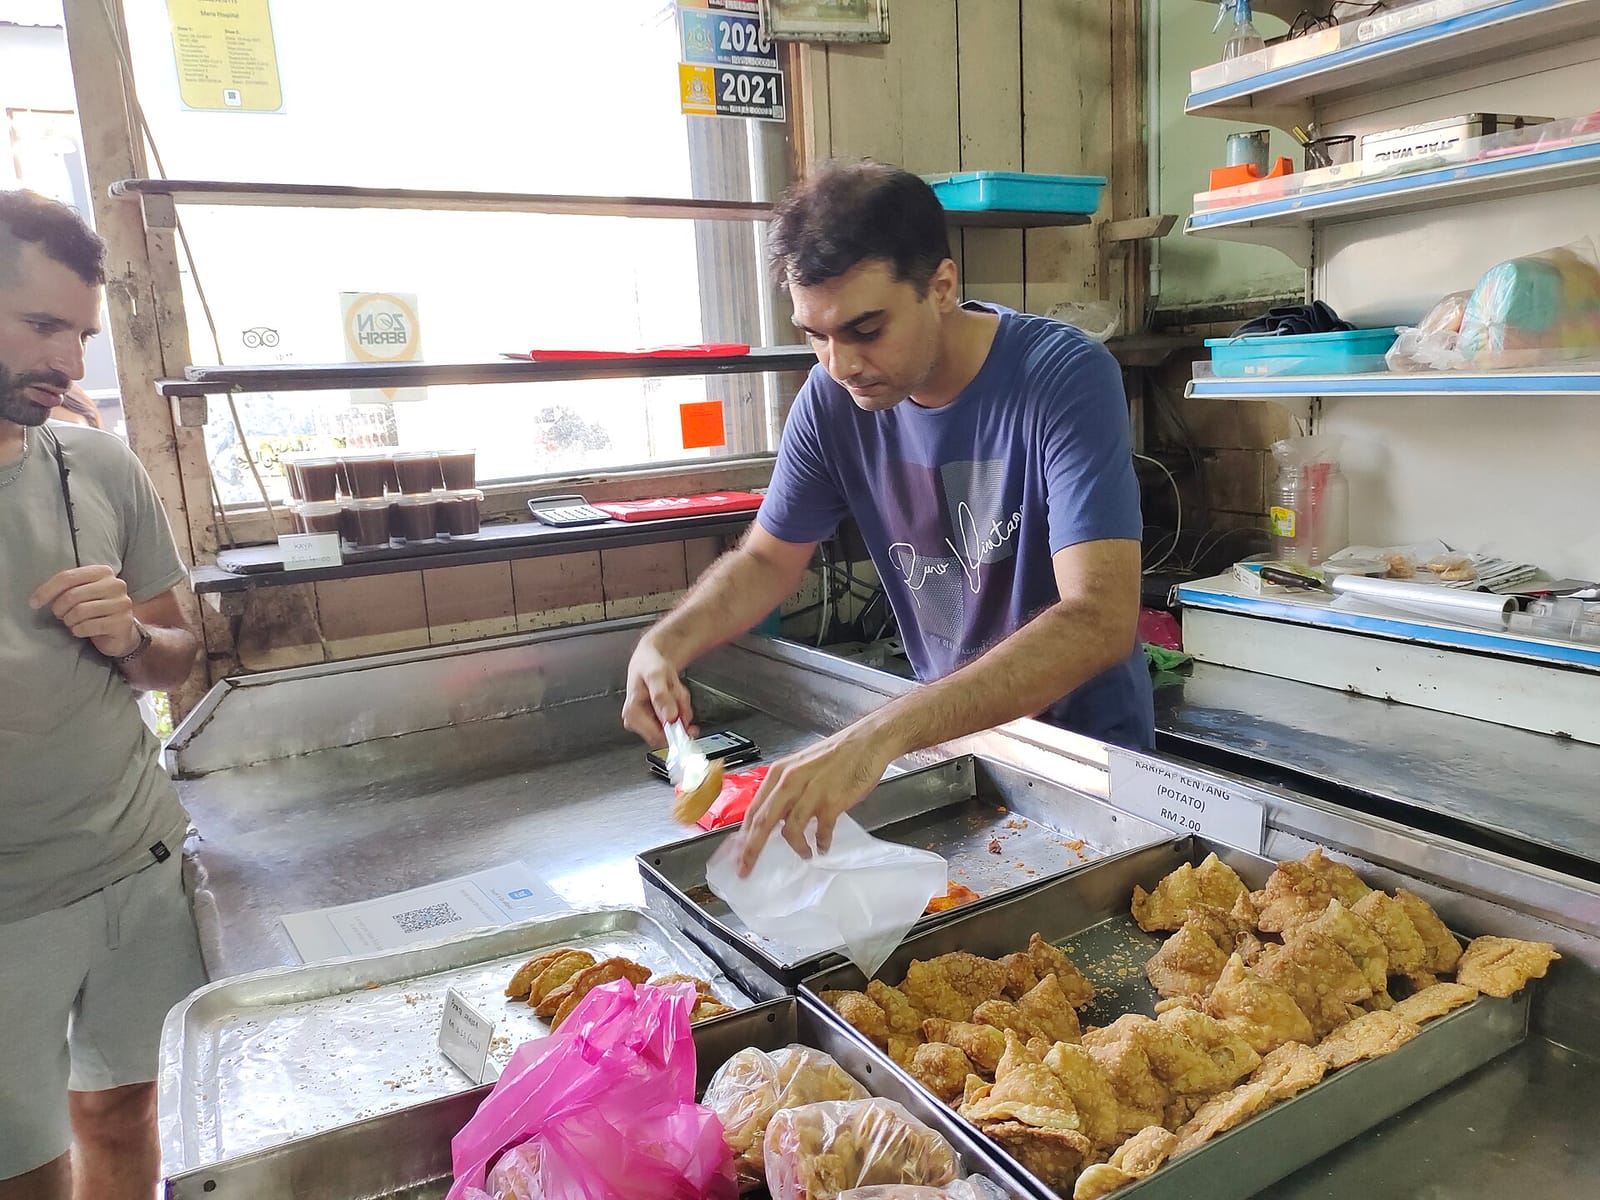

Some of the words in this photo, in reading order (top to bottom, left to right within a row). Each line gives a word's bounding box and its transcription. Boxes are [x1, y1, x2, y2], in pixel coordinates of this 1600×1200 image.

[721, 73, 778, 105] 2021
[1415, 138, 1460, 155] STAR
[1157, 784, 1206, 813] (POTATO)
[1160, 807, 1178, 823] RM
[1179, 816, 1201, 832] 2.00
